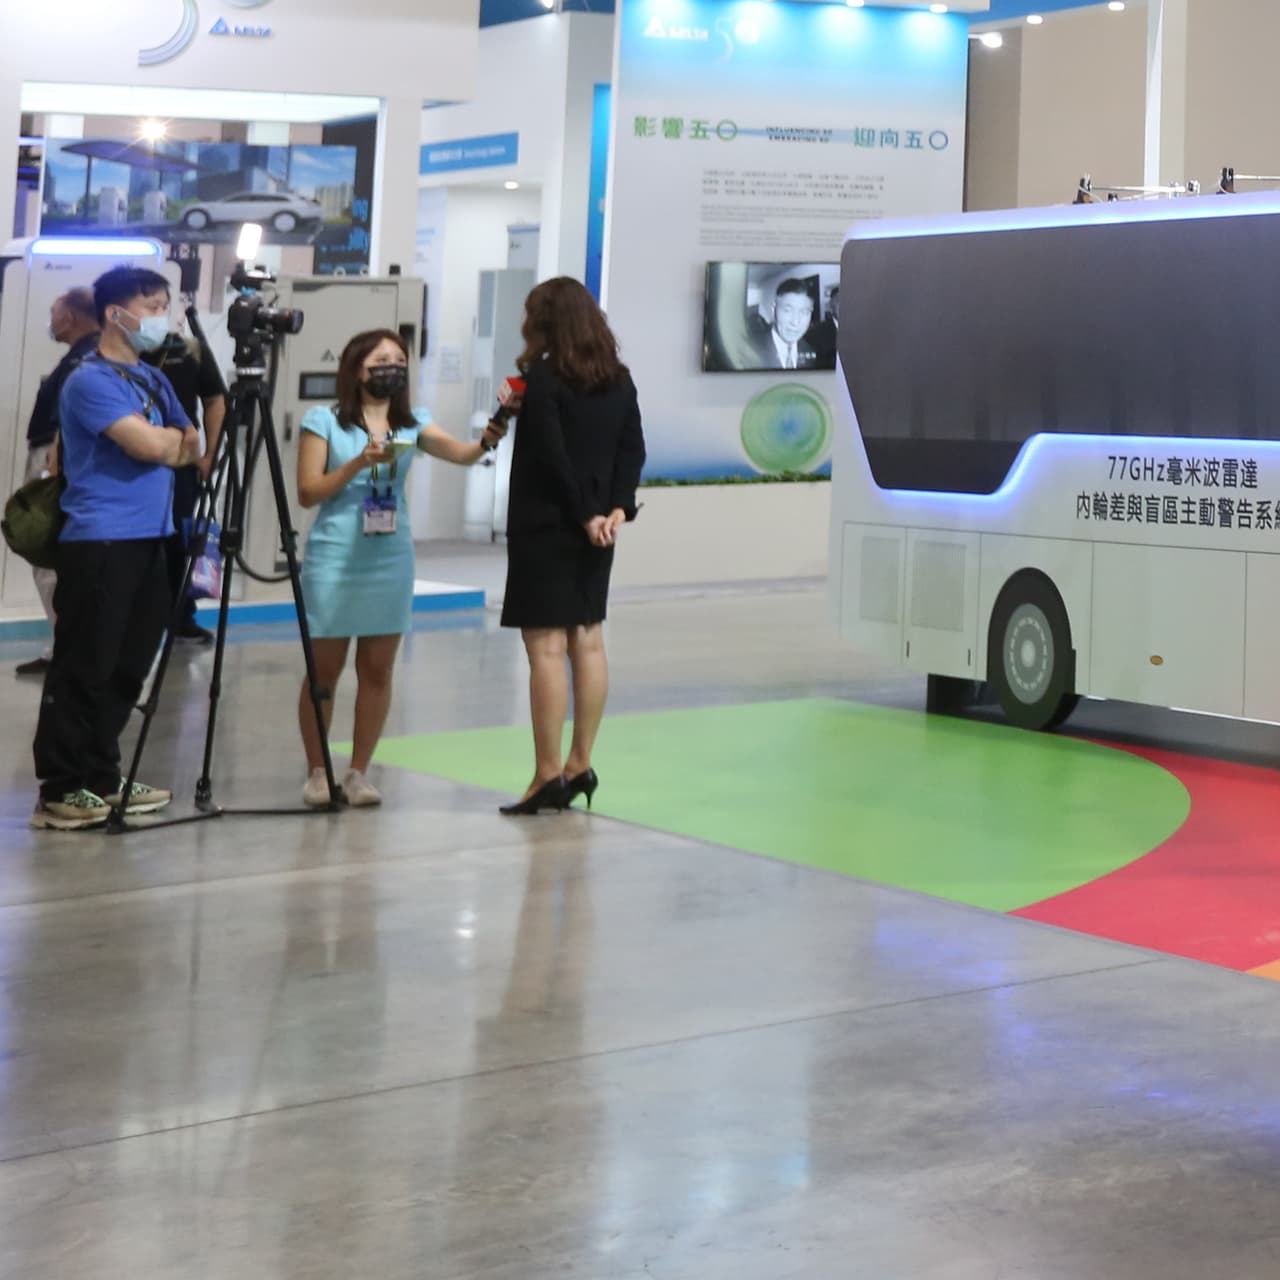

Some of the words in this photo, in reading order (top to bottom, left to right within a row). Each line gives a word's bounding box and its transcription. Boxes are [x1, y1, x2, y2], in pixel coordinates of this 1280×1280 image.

[1108, 456, 1259, 489] 77GHz毫米波雷達
